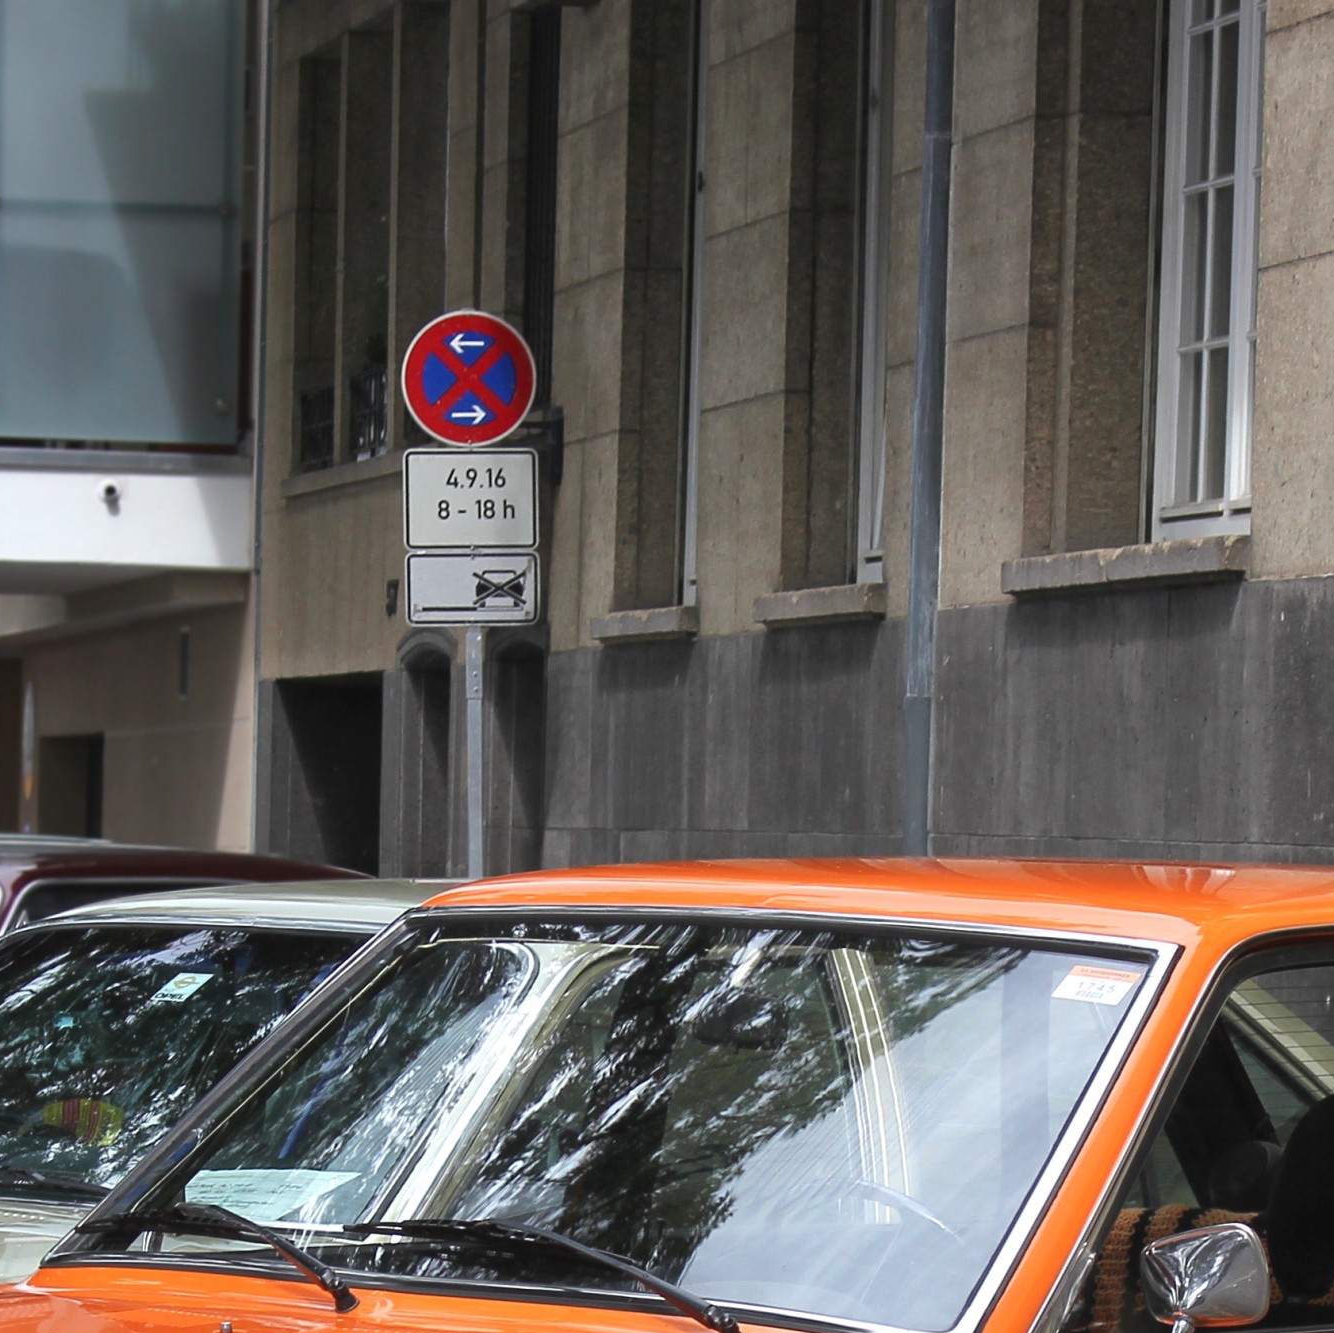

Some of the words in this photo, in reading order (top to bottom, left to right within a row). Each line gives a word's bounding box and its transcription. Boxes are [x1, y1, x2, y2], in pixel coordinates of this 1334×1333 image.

[446, 467, 506, 488] 4.9.16
[438, 499, 450, 520] 8
[475, 499, 495, 520] 18
[503, 499, 515, 519] h
